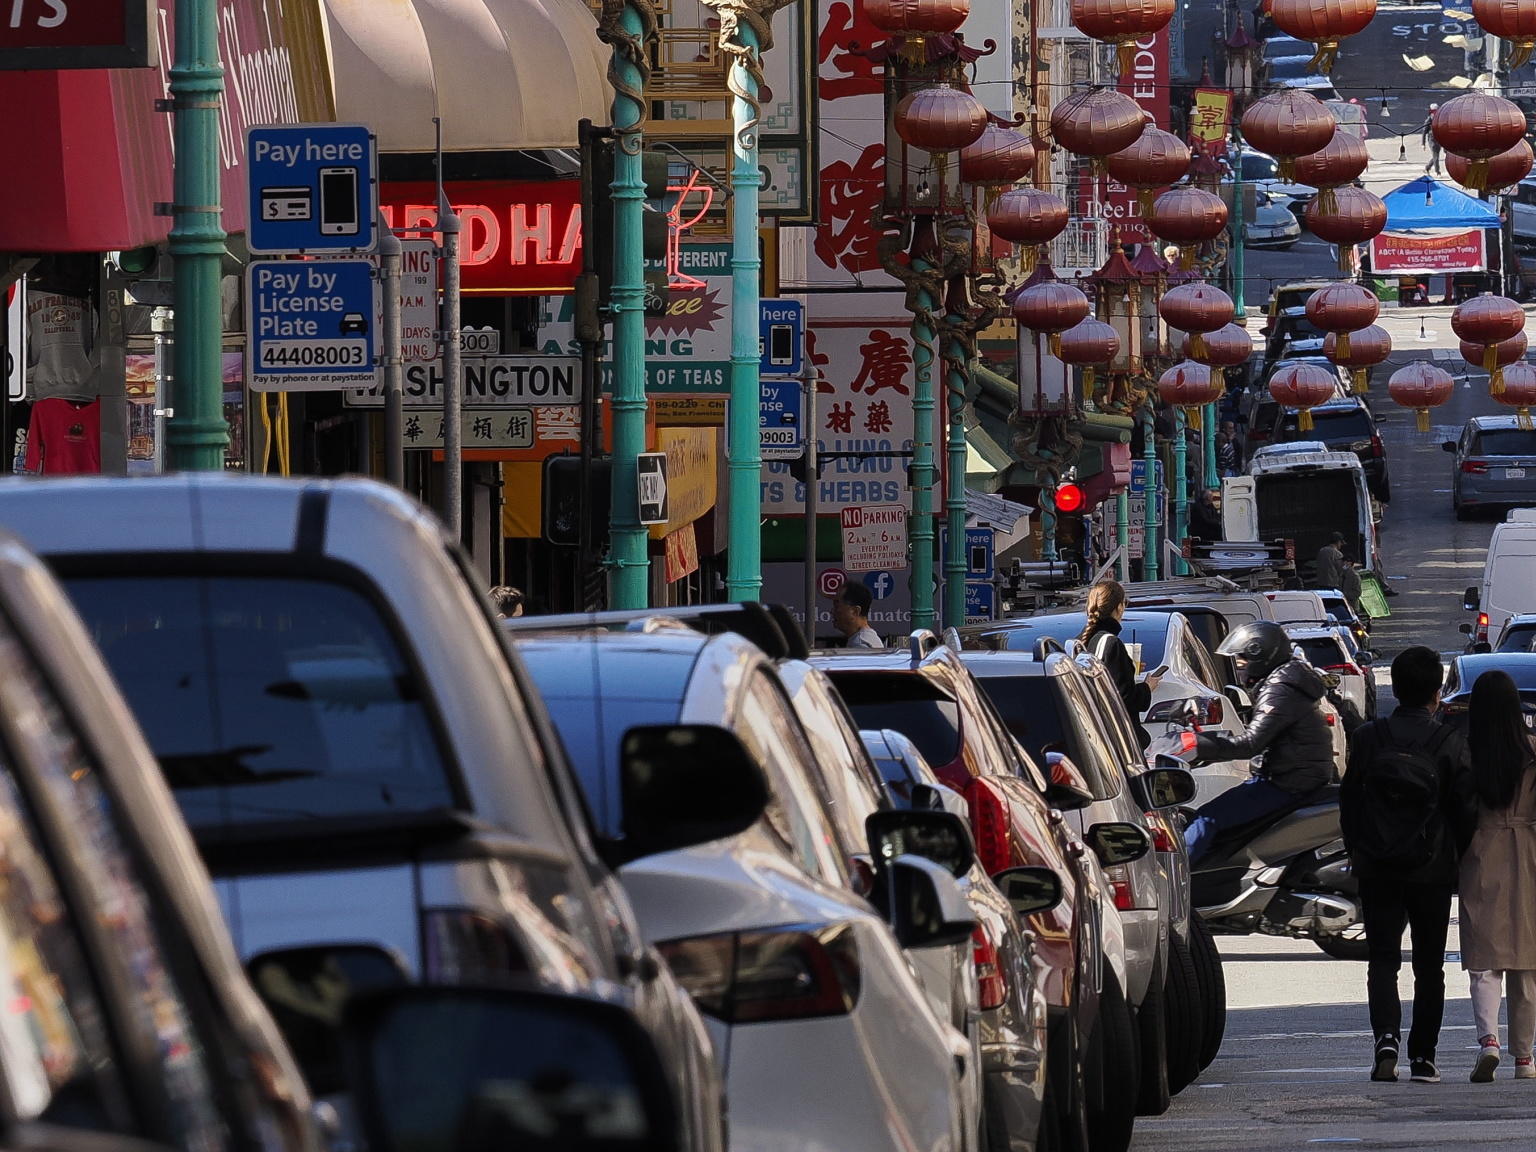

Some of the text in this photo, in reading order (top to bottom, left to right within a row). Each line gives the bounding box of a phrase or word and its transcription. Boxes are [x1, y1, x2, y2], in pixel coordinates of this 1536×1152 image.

[255, 138, 363, 167] Pay here
[259, 268, 336, 294] Pay by
[259, 293, 344, 313] License
[762, 307, 797, 320] here
[259, 316, 318, 337] Plate
[263, 346, 363, 366] 44408003
[253, 374, 268, 385] Pay
[270, 374, 281, 385] by
[283, 373, 307, 385] phone
[321, 374, 330, 382] at
[332, 373, 375, 384] paystation
[683, 369, 723, 385] TEAS
[762, 385, 779, 399] by
[403, 415, 529, 443] 華頓街
[820, 480, 899, 503] HERBS
[843, 509, 904, 526] NO PARKING
[966, 534, 990, 544] here
[861, 544, 890, 553] EVERYDAY
